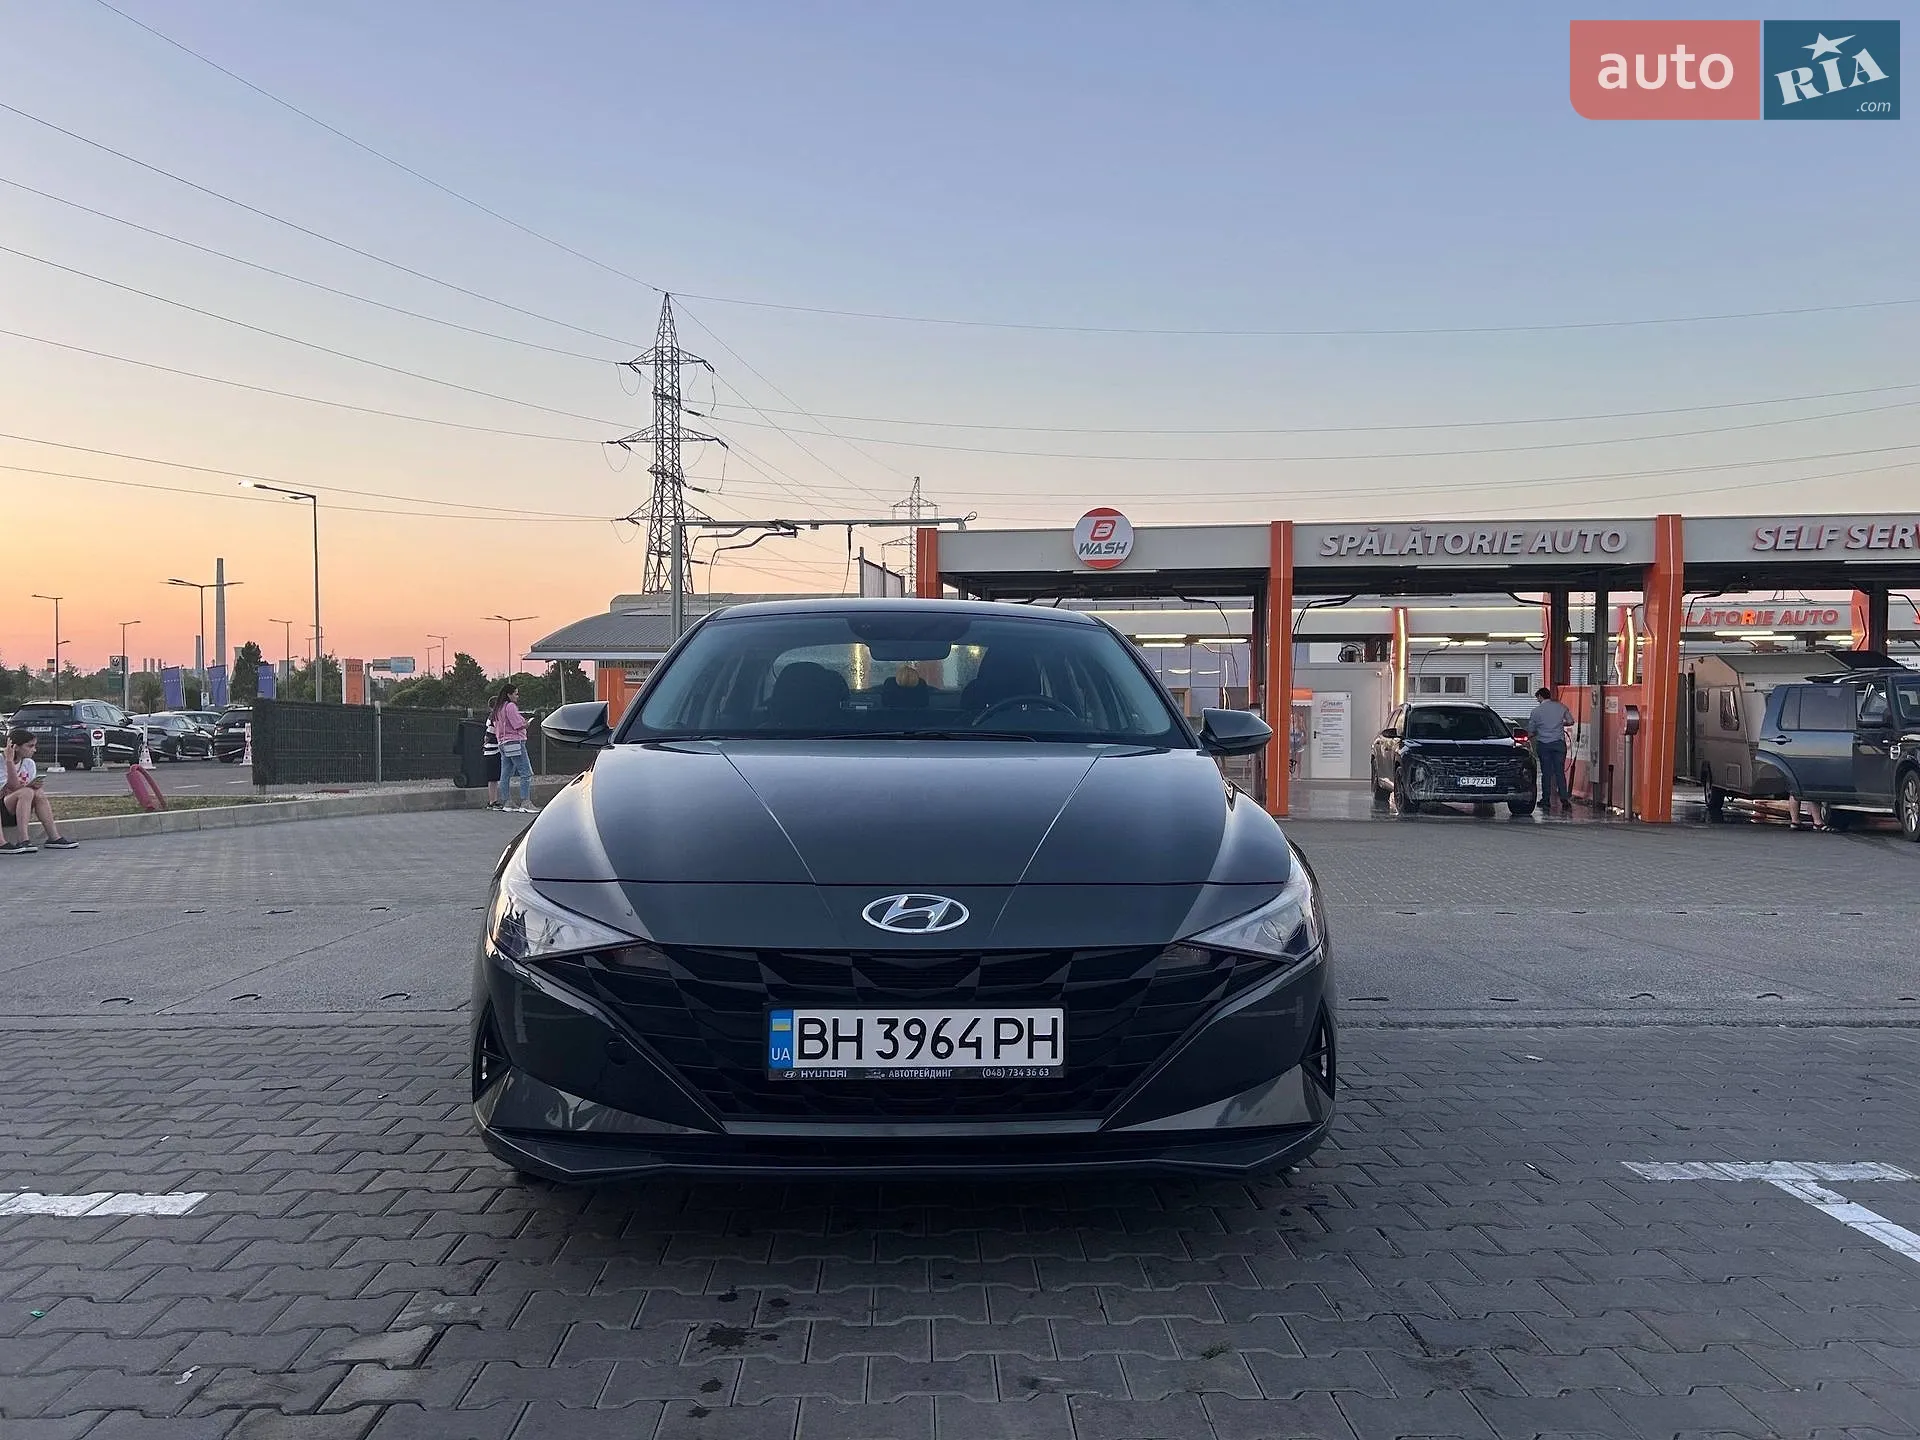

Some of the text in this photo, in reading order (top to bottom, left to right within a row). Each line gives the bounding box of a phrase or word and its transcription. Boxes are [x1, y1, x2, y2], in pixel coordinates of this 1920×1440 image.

[1319, 526, 1628, 557] SPĂLĂTORIE AUTO
[1752, 522, 1920, 551] SELF SER
[1078, 541, 1128, 556] WASH
[1776, 608, 1839, 627] AUTO
[797, 1016, 1059, 1060] BH 3964 PH
[771, 1048, 791, 1062] UA
[800, 1069, 847, 1078] HYUNDAI
[888, 1068, 953, 1079] АВТОТРЕЙДИНГ
[982, 1067, 1050, 1079] (048) 734 36 63
